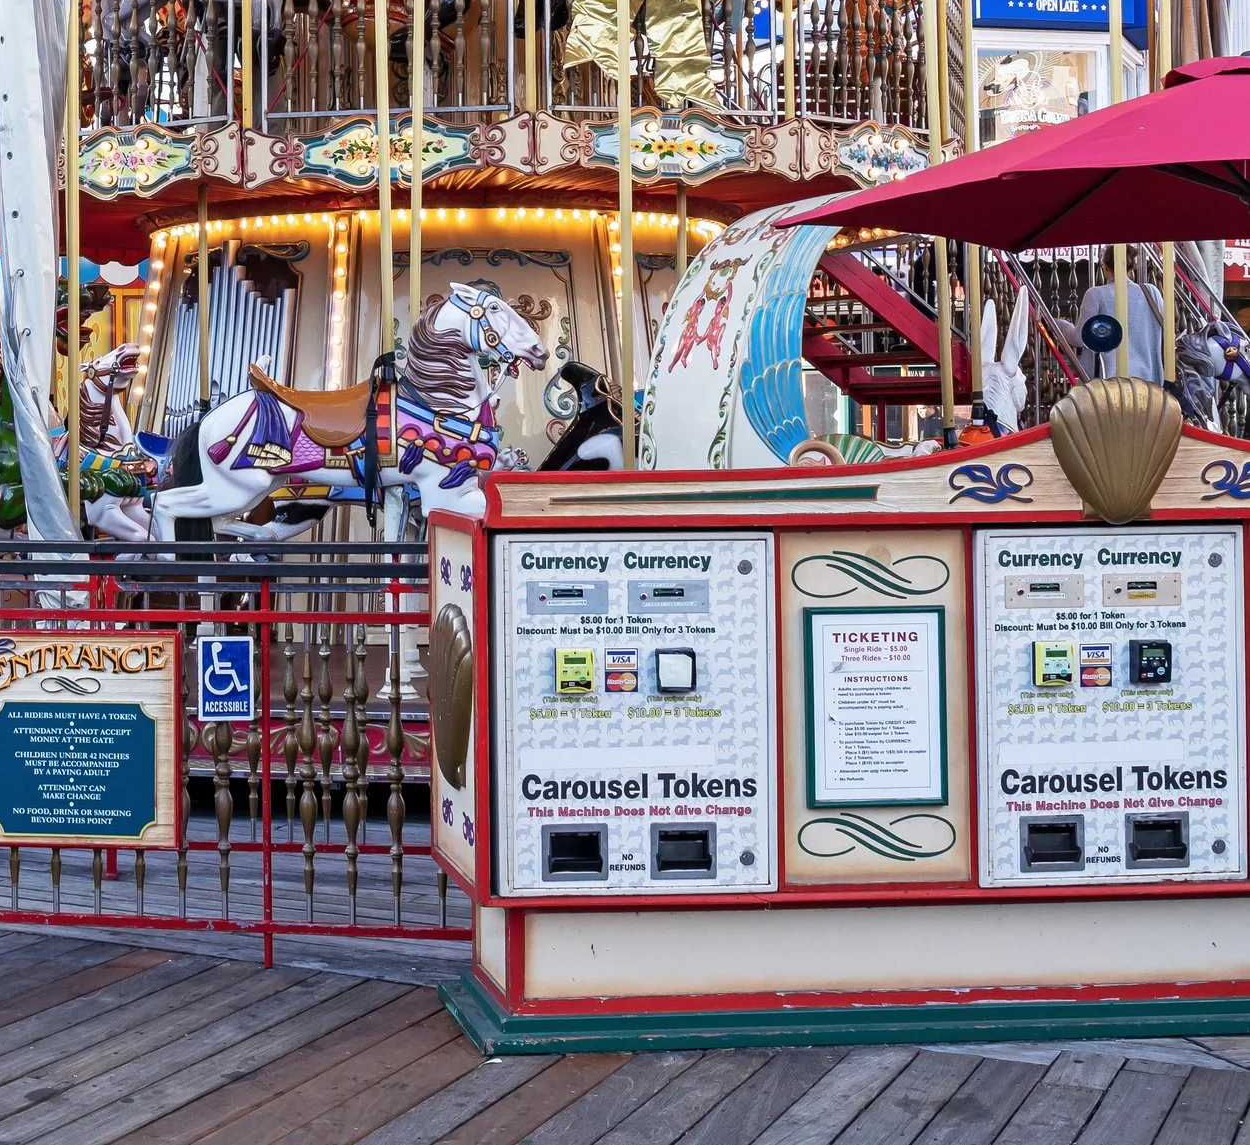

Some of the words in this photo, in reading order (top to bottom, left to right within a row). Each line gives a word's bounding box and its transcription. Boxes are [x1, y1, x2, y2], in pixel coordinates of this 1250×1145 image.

[1036, 0, 1058, 11] OPEN
[1060, 0, 1079, 12] LATE
[521, 552, 609, 572] Currency
[623, 552, 711, 572] Currency
[999, 550, 1083, 569] Currency
[1098, 548, 1182, 567] Currency
[580, 616, 603, 625] $5.00
[605, 616, 617, 624] for
[627, 616, 652, 624] Token
[1080, 612, 1092, 620] for
[517, 627, 557, 635] Discount:
[596, 626, 623, 635] $10.00
[626, 626, 639, 634] Bill
[642, 626, 661, 636] Only
[995, 624, 1033, 632] Discount:
[1037, 623, 1057, 631] Must
[1059, 623, 1069, 631] be
[1116, 622, 1134, 631] Only
[833, 632, 918, 643] TICKETING
[612, 656, 631, 664] VISA
[205, 701, 248, 712] ACCESSIBLE
[530, 708, 558, 720] $5.00
[571, 709, 576, 718] 1
[579, 708, 611, 719] Token
[628, 708, 661, 719] $10.00
[674, 708, 681, 718] 3
[684, 708, 721, 718] Tokens
[1001, 767, 1122, 794] Carousel
[1132, 765, 1227, 791] Tokens
[522, 773, 648, 800] Carousel
[658, 773, 757, 799] Tokens
[1006, 801, 1032, 812] This
[1036, 800, 1086, 811] Machine
[1090, 799, 1119, 809] Does
[1124, 798, 1144, 808] Not
[1148, 797, 1174, 808] Give
[1178, 796, 1222, 808] Change
[528, 807, 554, 817] This
[558, 807, 610, 817] Machine
[615, 806, 645, 816] Does
[650, 806, 670, 816] Not
[675, 805, 702, 816] Give
[706, 805, 752, 816] Change
[1086, 856, 1121, 864] REFUNDS
[610, 863, 646, 871] REFUNDS
